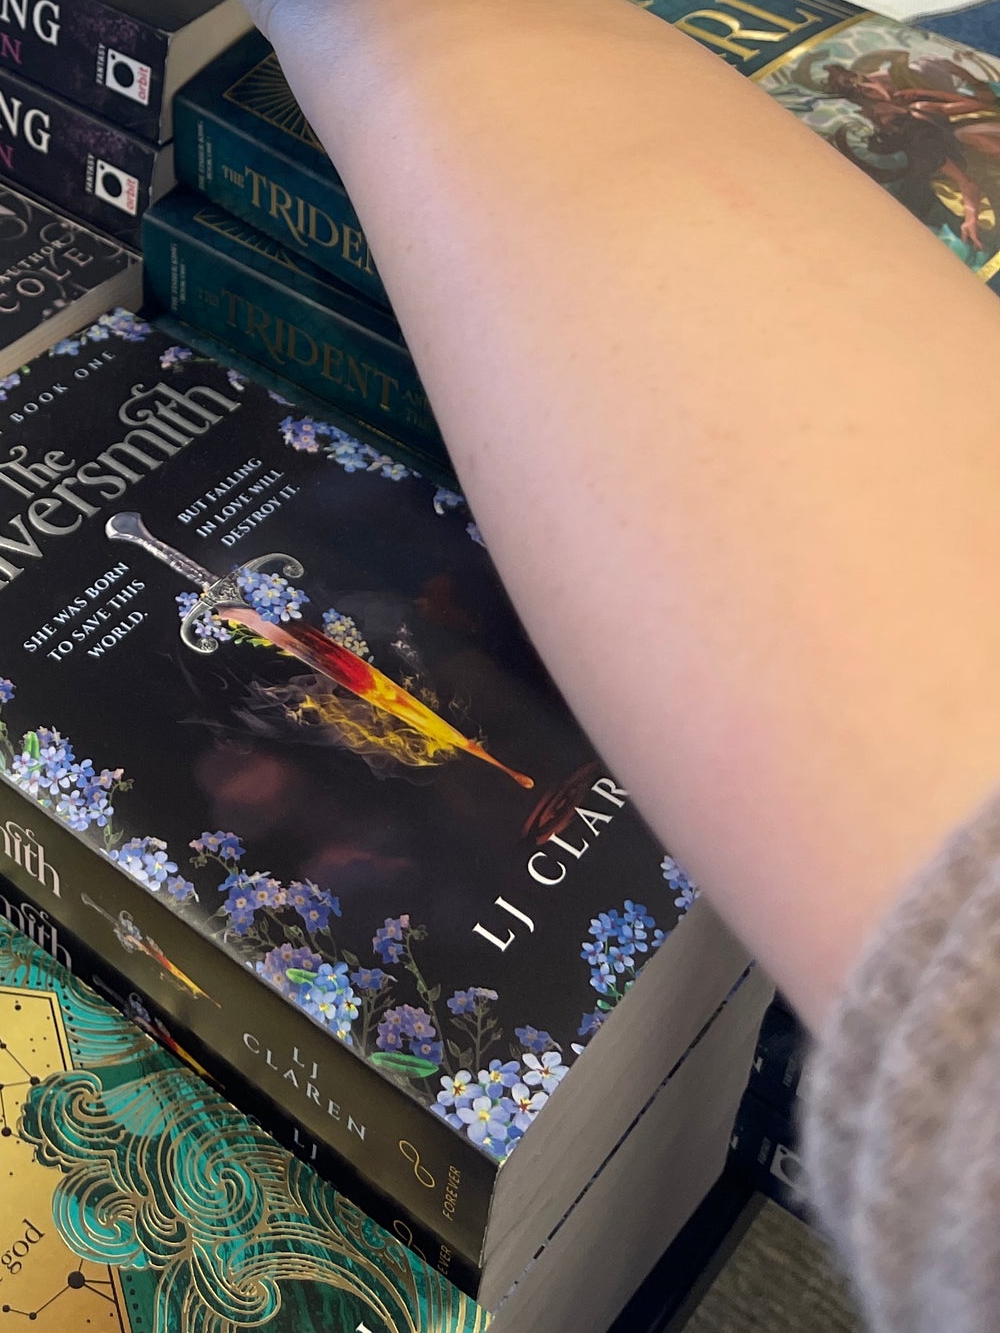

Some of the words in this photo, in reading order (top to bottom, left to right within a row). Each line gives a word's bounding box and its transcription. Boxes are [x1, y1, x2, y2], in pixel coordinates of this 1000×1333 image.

[136, 66, 150, 101] orbit
[84, 152, 95, 194] FANTASY
[125, 178, 137, 211] orbit
[220, 289, 399, 412] TRIDENT
[8, 382, 69, 424] BOOK
[73, 350, 118, 380] ONE
[176, 497, 207, 526] BUT
[206, 457, 263, 504] FALLING
[195, 520, 216, 539] IN
[213, 495, 251, 525] LOVE
[247, 468, 286, 500] WILL
[219, 496, 285, 548] DESTROY
[278, 483, 301, 503] IT.
[22, 623, 58, 654] SHE
[52, 596, 89, 628] WAS
[84, 560, 131, 600] BORN
[46, 638, 74, 664] TO
[71, 608, 113, 643] SAVE
[107, 577, 147, 612] THIS
[87, 608, 150, 661] WORLD.
[471, 895, 535, 953] LJ
[526, 776, 631, 887] CLAR
[242, 1032, 367, 1143] CLAREN
[293, 1047, 318, 1080] LJ
[441, 1164, 463, 1222] FOREVER
[0, 1217, 47, 1276] god
